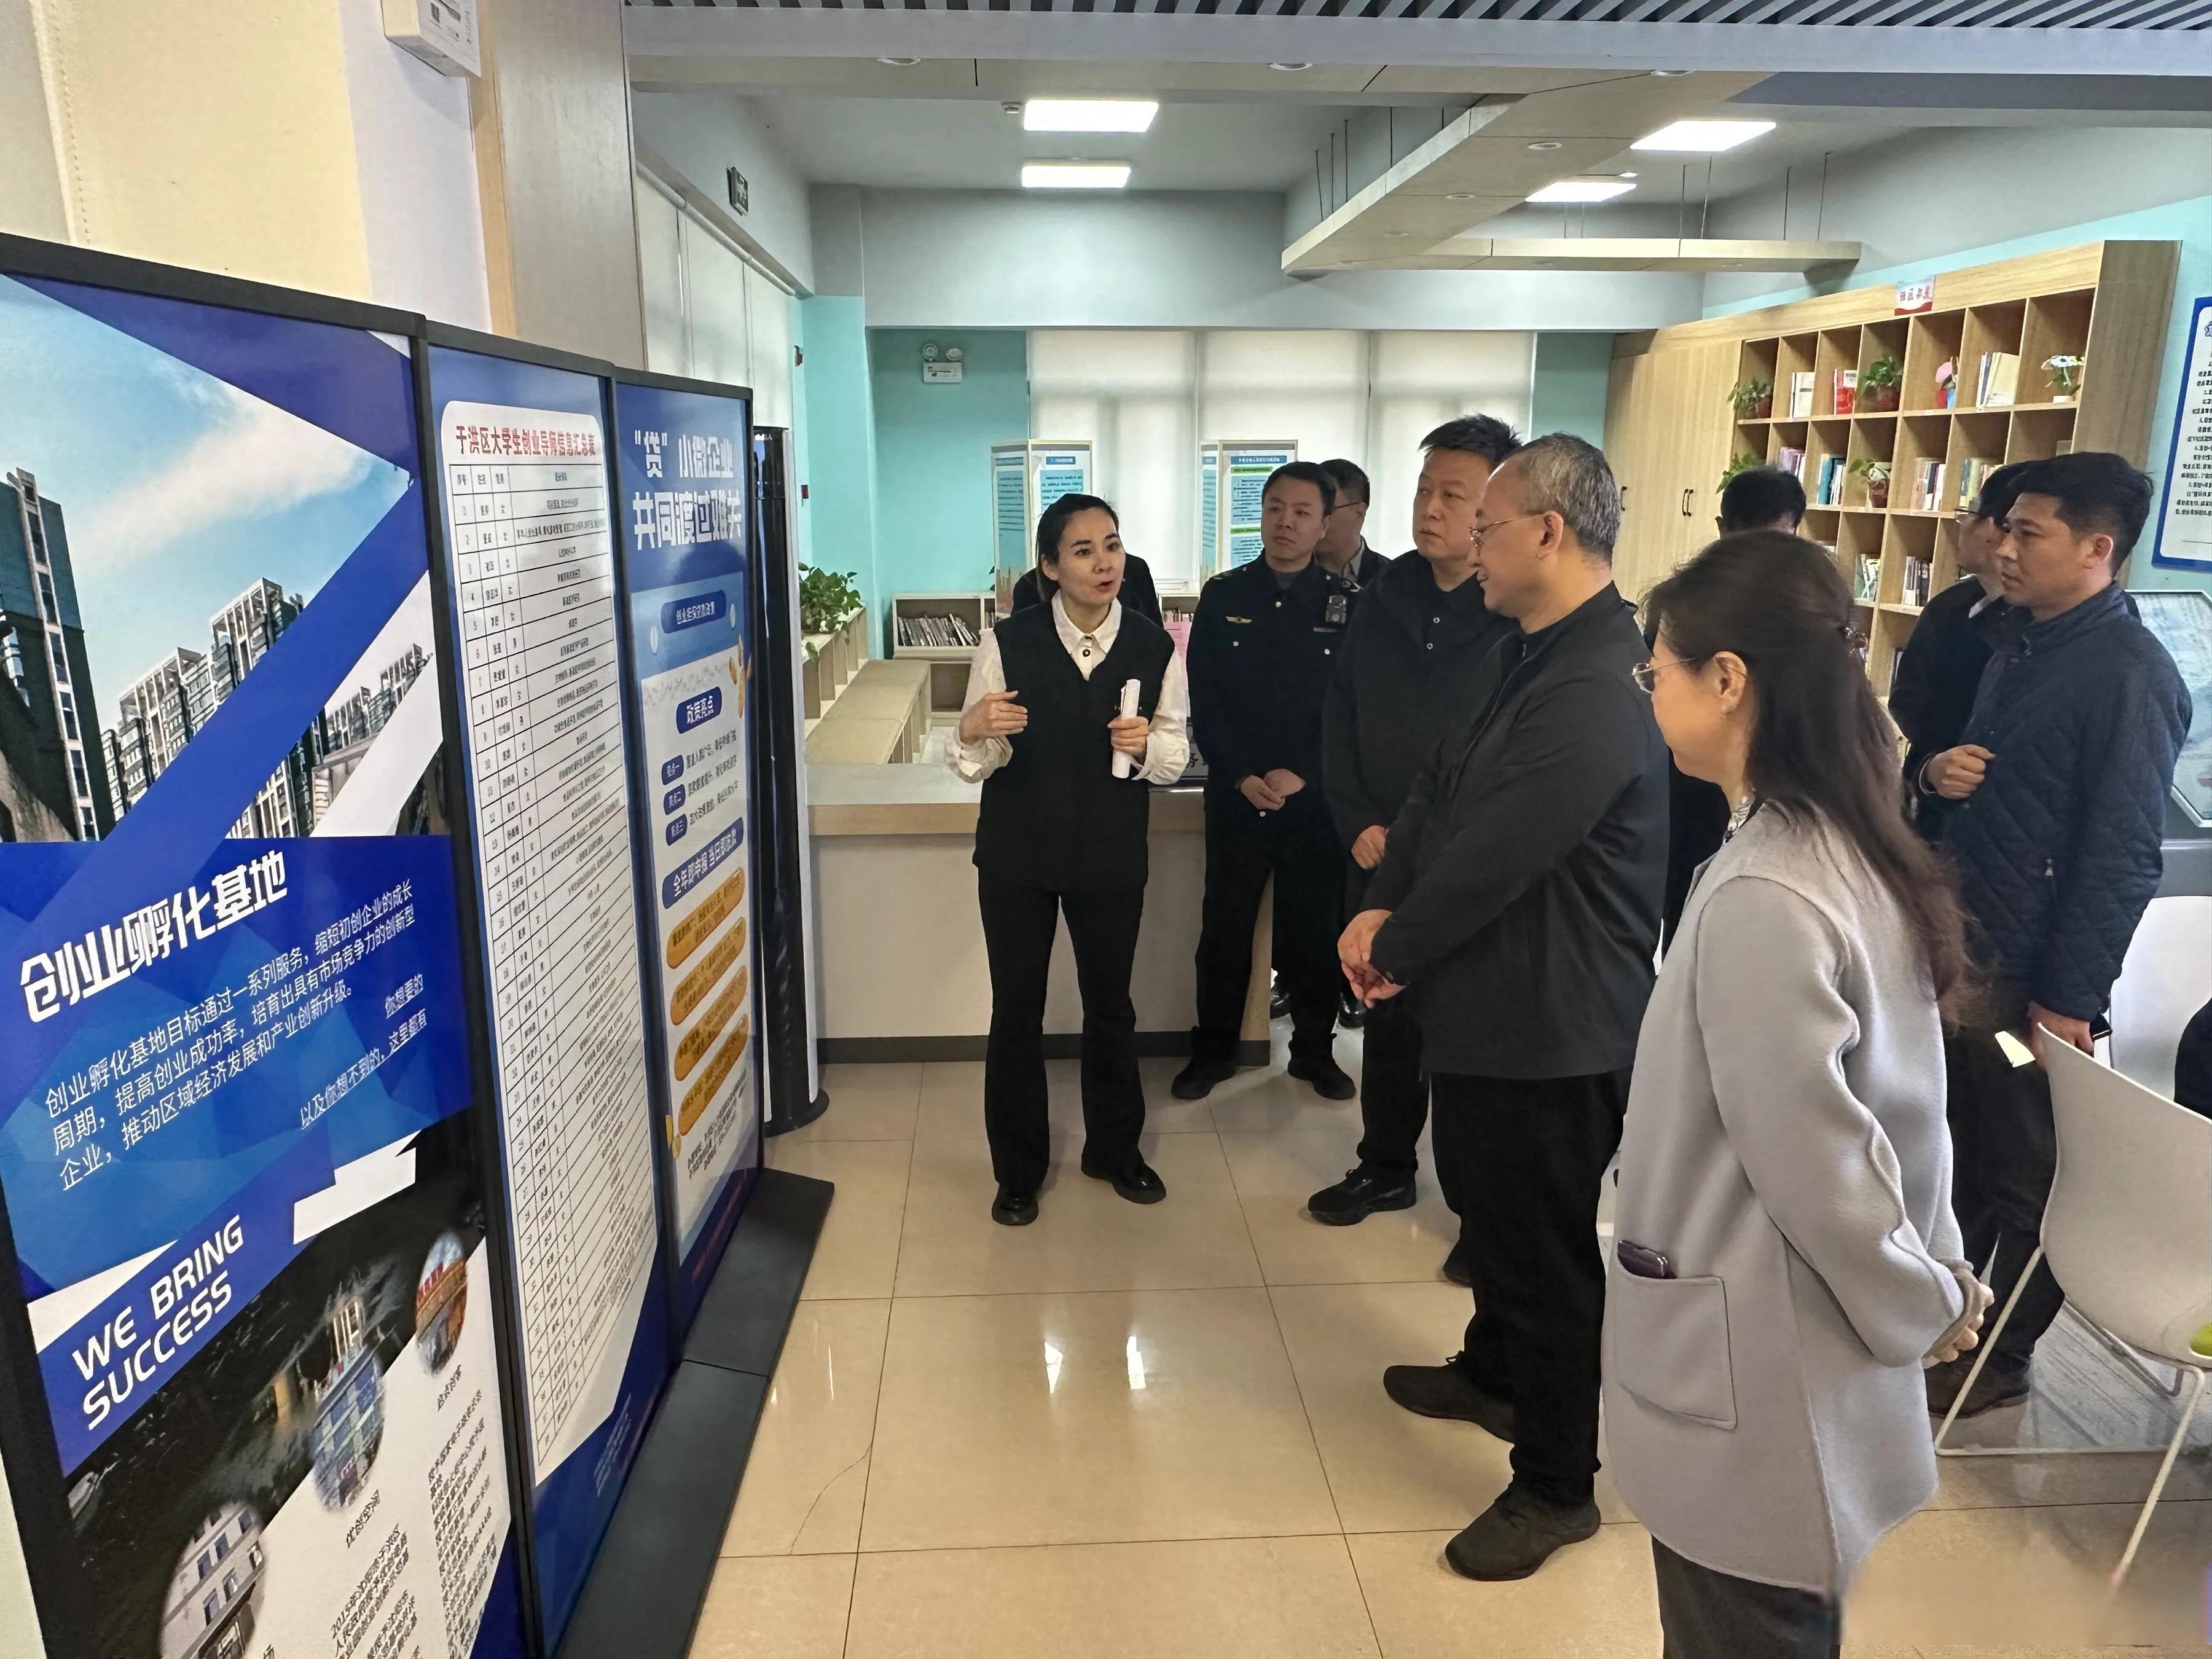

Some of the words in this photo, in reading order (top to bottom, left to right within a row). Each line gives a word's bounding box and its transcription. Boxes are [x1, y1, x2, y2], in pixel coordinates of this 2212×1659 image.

[678, 434, 734, 478] 小微企业
[20, 850, 288, 1023] 创业孵化基地
[385, 973, 424, 1018] 你想要的
[60, 979, 352, 1191] 企业，推动区域经济发展和产业创新升级。
[71, 1306, 137, 1381] WE
[151, 1214, 243, 1316] BRING
[83, 1269, 233, 1430] SUCCESS
